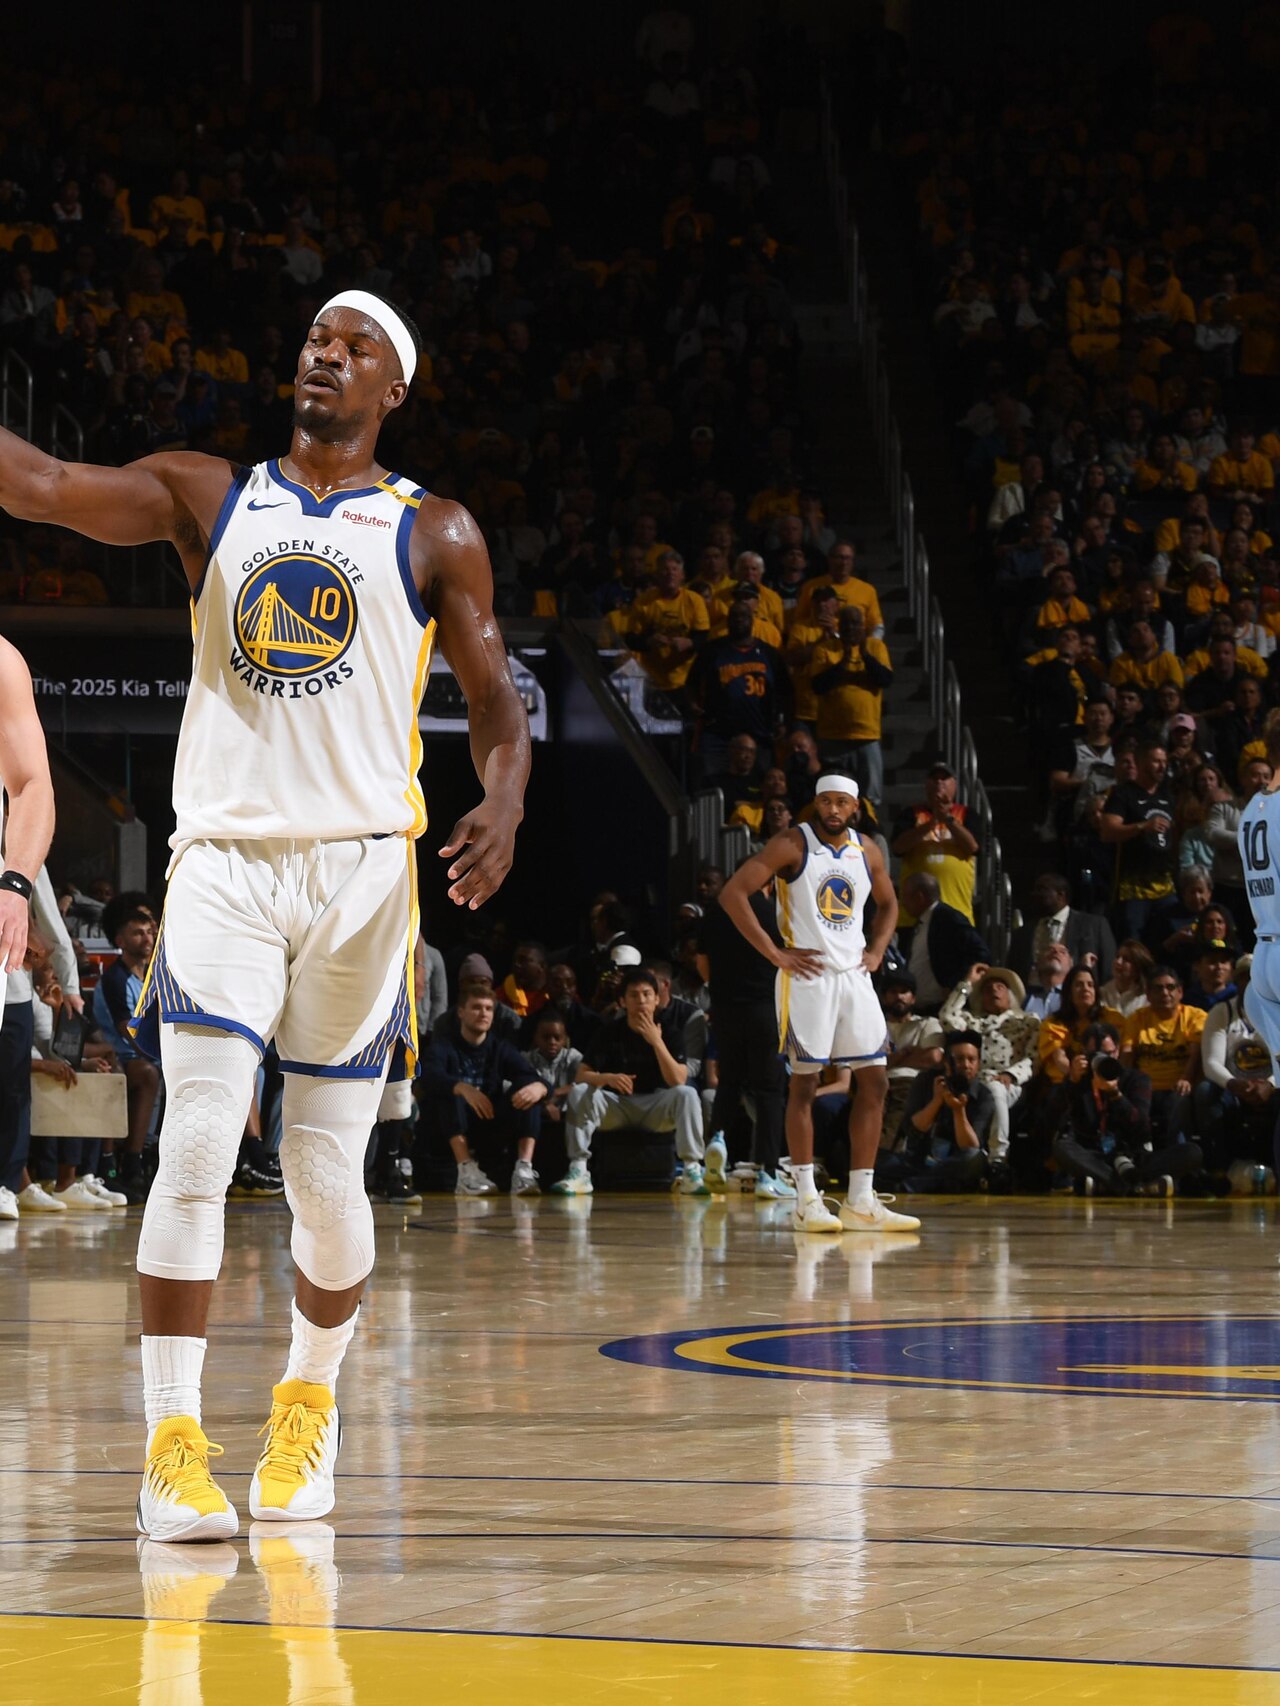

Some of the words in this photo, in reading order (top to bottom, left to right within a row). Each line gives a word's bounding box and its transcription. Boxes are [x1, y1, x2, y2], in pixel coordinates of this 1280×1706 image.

[342, 510, 392, 529] Rakuten
[242, 540, 314, 573] GOLDEN
[322, 545, 364, 585] STATE
[309, 586, 341, 621] 10
[33, 678, 66, 695] The
[71, 679, 116, 696] 2025
[122, 680, 150, 697] Kia
[230, 647, 353, 699] WARRIORS
[744, 674, 766, 697] 30
[1243, 820, 1269, 870] 10
[841, 888, 849, 902] 4
